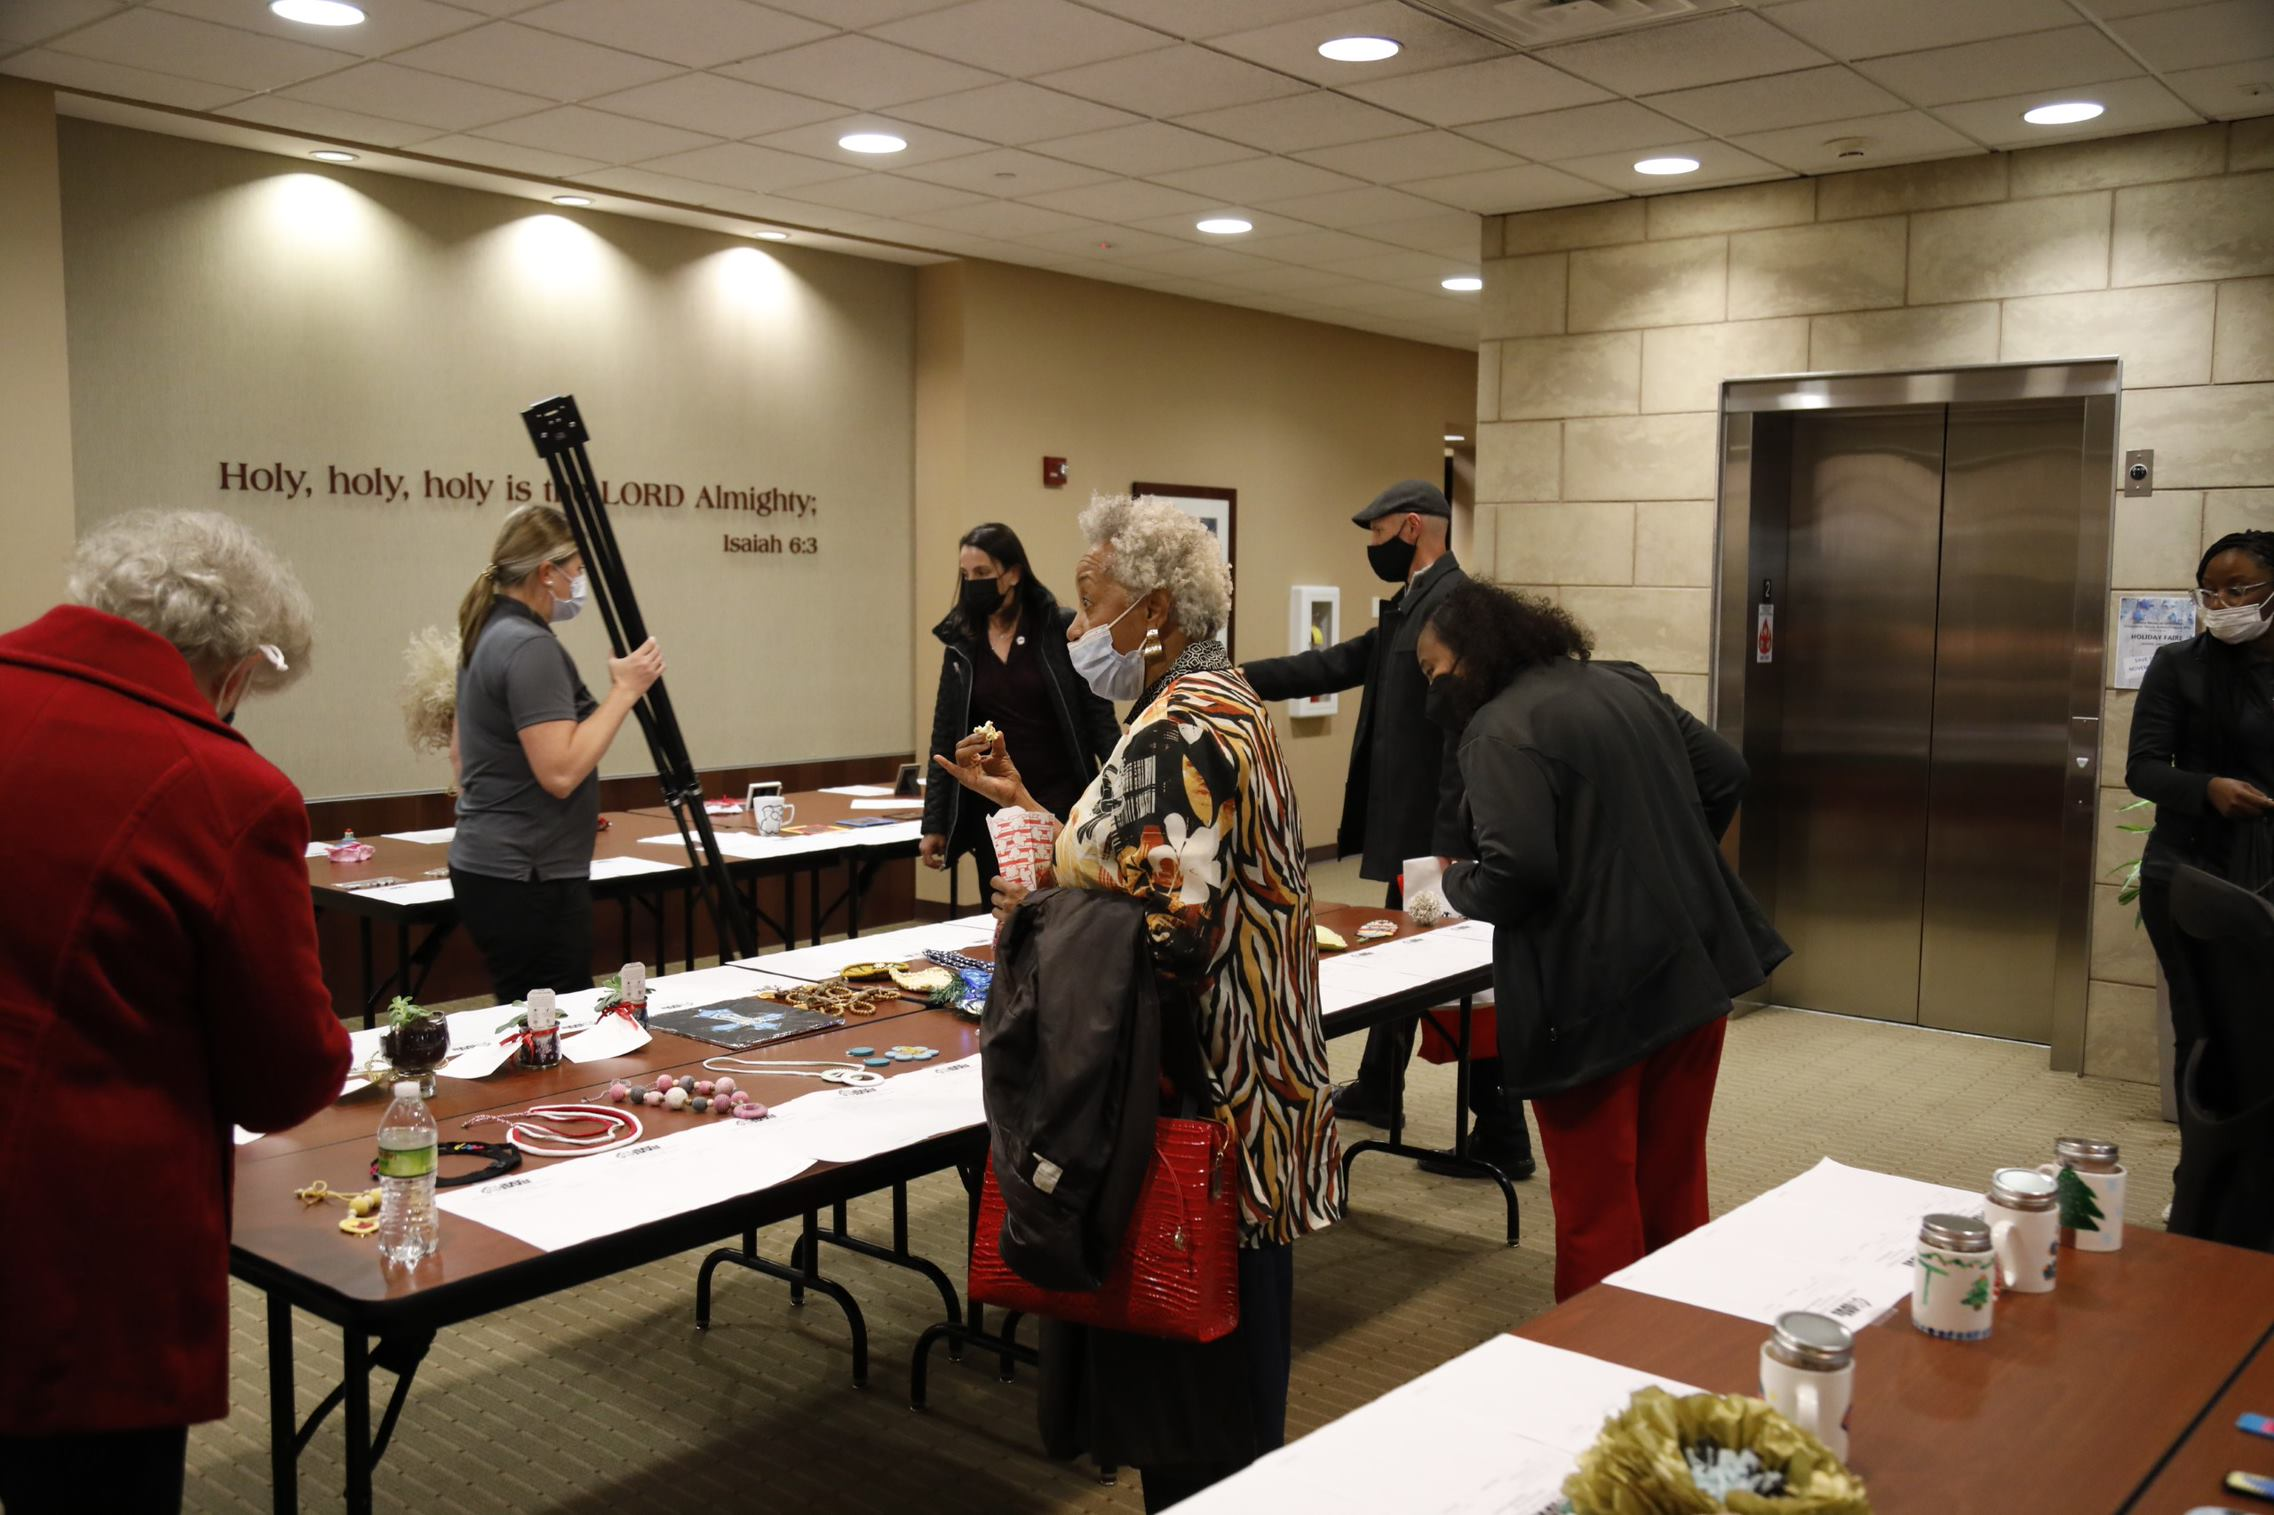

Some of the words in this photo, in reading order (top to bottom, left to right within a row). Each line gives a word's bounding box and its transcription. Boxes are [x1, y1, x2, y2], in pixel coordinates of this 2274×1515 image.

[219, 461, 312, 499] Holy,
[328, 465, 409, 503] holy,
[423, 469, 494, 506] holy
[506, 474, 532, 502] is
[601, 480, 685, 507] LORD
[695, 484, 817, 518] Almighty;
[722, 533, 782, 553] Isaiah
[788, 536, 818, 554] 6:3
[2131, 633, 2162, 641] HOLIDAY
